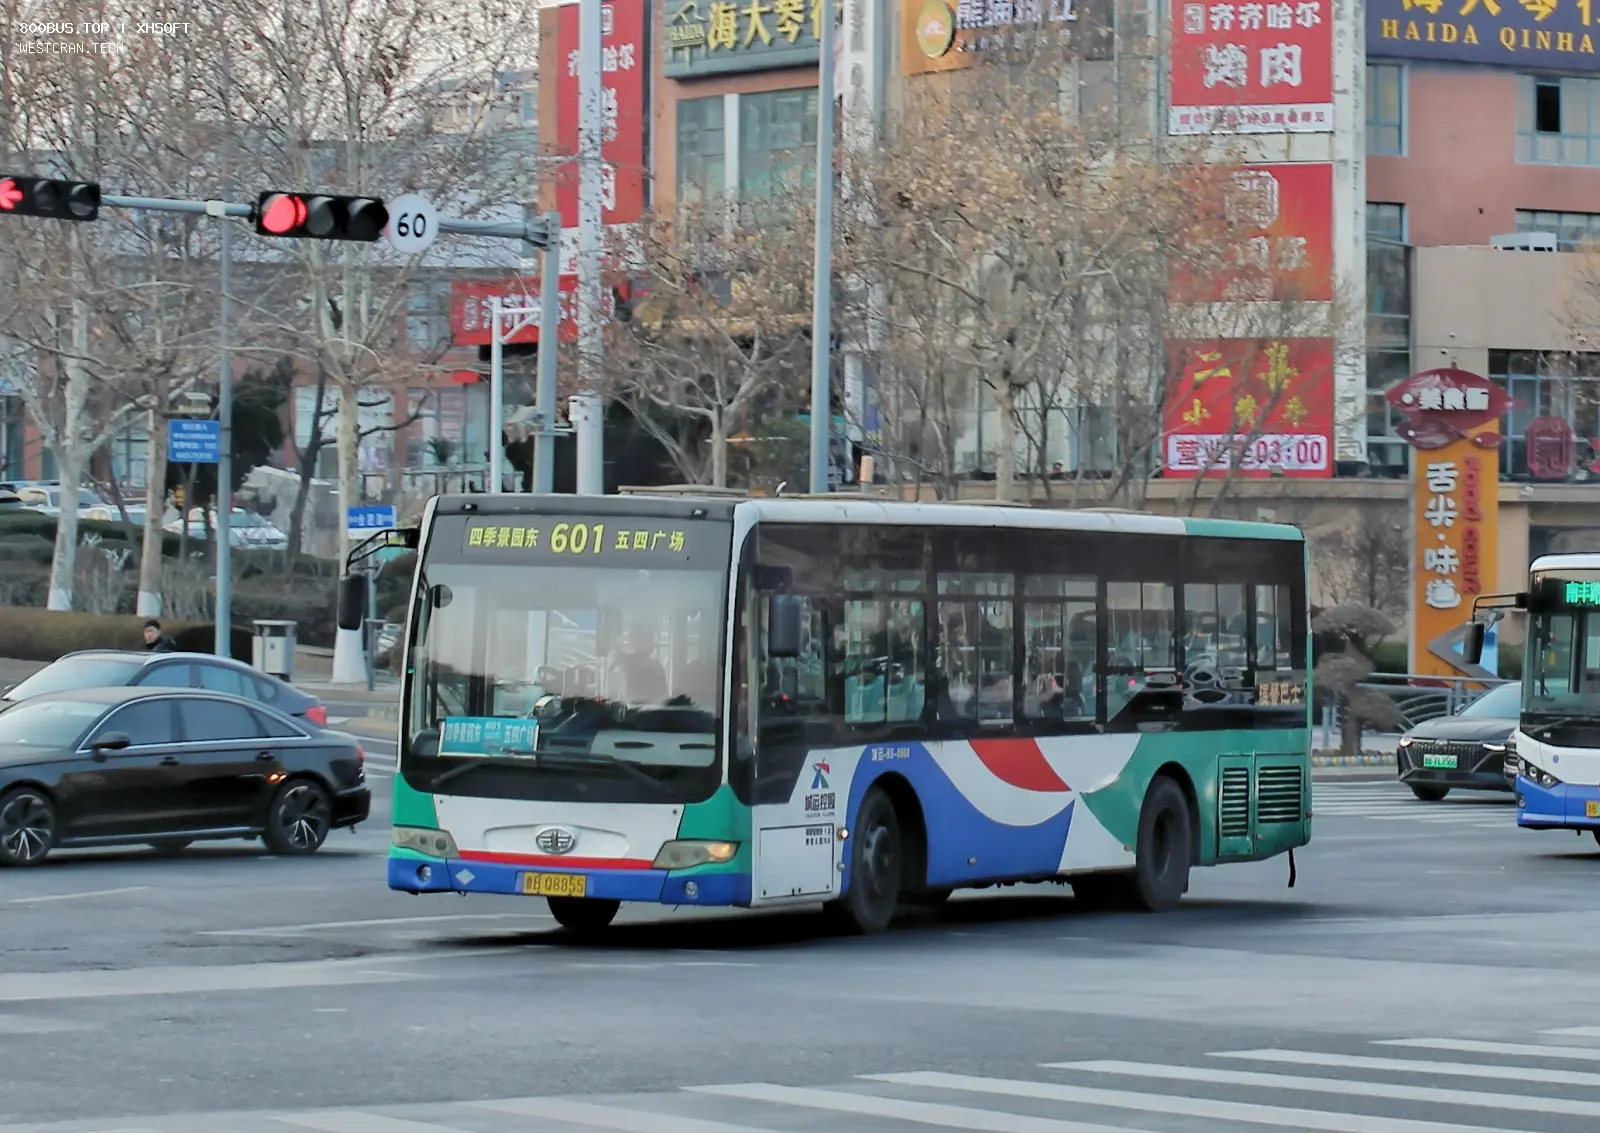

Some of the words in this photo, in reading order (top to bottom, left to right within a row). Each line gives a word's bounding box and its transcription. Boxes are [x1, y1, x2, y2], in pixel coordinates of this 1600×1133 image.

[1209, 2, 1321, 31] 齐齐哈尔
[1381, 18, 1480, 45] HAIDA
[1500, 27, 1596, 54] QINHA
[397, 212, 426, 238] 60
[469, 527, 540, 548] 四季景园东
[551, 523, 604, 554] 601
[615, 531, 685, 552] 五四广场
